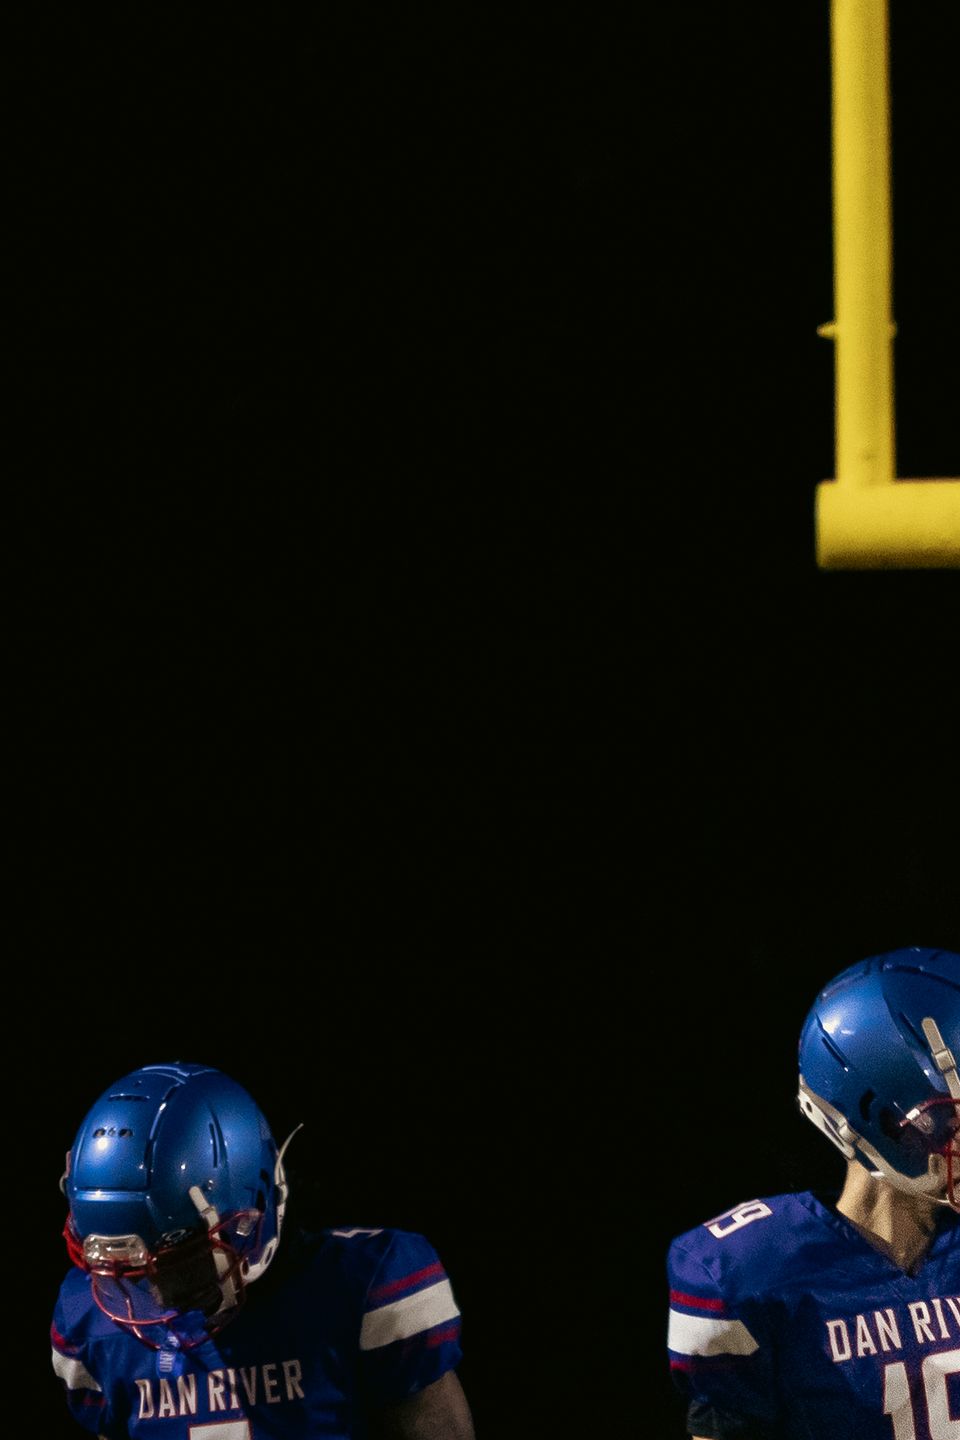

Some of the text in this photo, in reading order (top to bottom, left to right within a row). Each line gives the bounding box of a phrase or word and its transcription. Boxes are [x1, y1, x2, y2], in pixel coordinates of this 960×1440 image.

[826, 1308, 902, 1363] DAN
[135, 1359, 305, 1419] DAN RIVER
